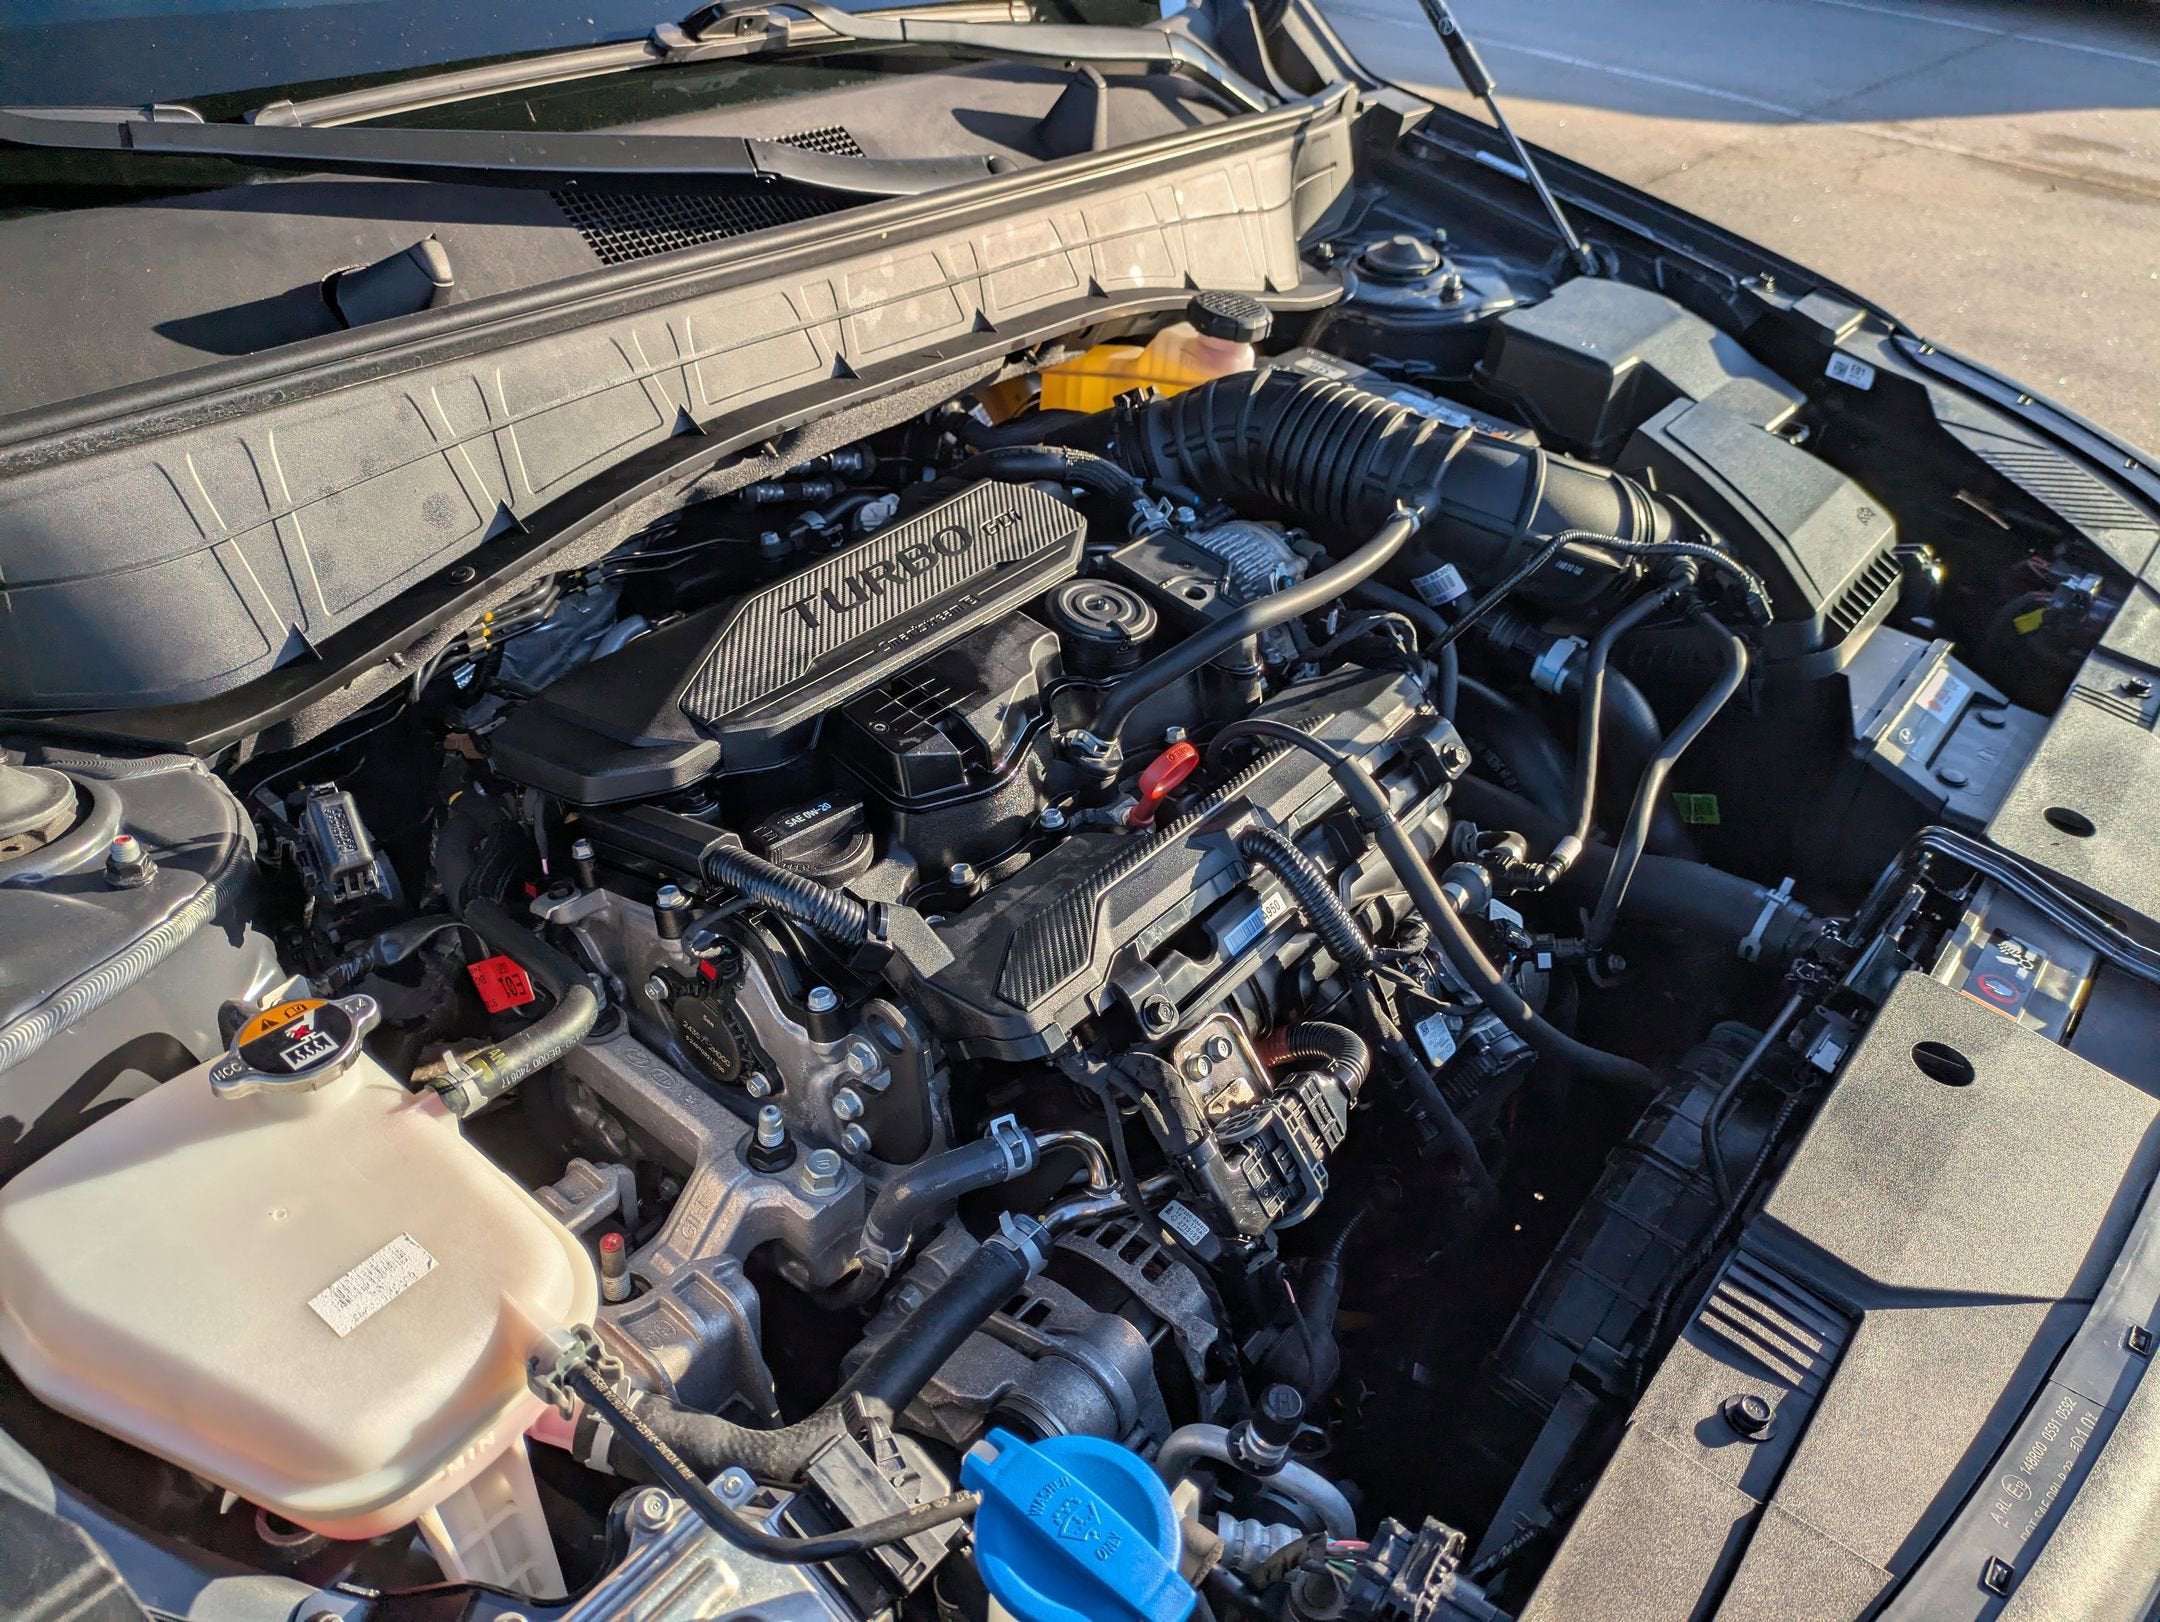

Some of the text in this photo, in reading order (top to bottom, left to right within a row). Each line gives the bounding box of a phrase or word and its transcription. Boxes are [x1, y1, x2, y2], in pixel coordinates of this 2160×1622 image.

[781, 525, 973, 629] TURBO
[785, 802, 832, 828] SAE 0W-20
[498, 973, 526, 999] E01
[212, 1062, 242, 1081] HCC
[2056, 1396, 2077, 1420] 0592
[2042, 1418, 2062, 1441] 0591
[2020, 1441, 2048, 1476] 148R00
[1027, 1475, 1071, 1517] WASHER
[1995, 1499, 2012, 1514] RL
[1990, 1511, 2003, 1524] A
[1095, 1530, 1123, 1562] ONLY
